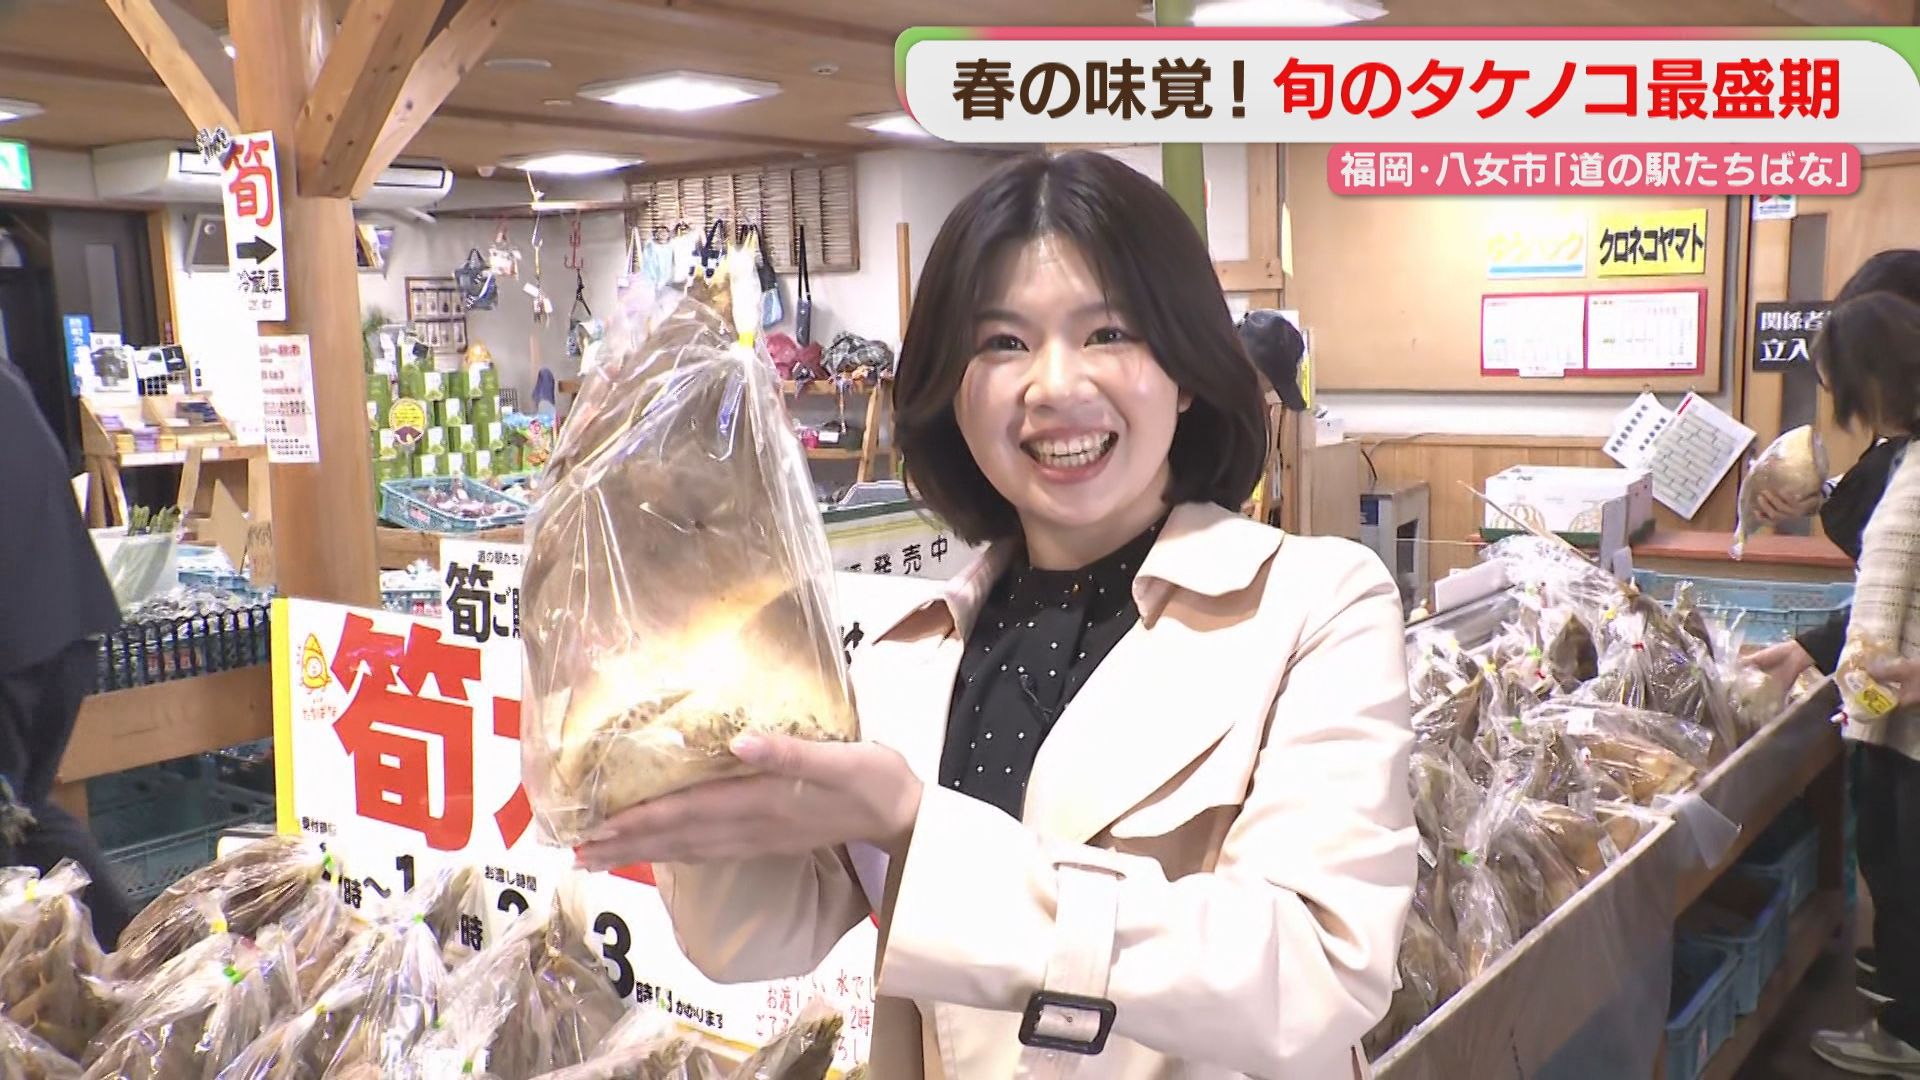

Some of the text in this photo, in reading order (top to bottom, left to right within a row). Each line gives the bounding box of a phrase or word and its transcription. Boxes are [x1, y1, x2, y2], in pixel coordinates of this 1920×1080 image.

[222, 139, 274, 227] 筍
[1600, 222, 1705, 267] クロネコヤマト
[237, 268, 283, 294] 冷蔵庫
[1760, 310, 1832, 333] 関係者
[1760, 337, 1811, 363] 立入
[477, 550, 525, 567] 道の駅たち
[484, 864, 537, 893] お渡し時間
[593, 911, 635, 999] 3
